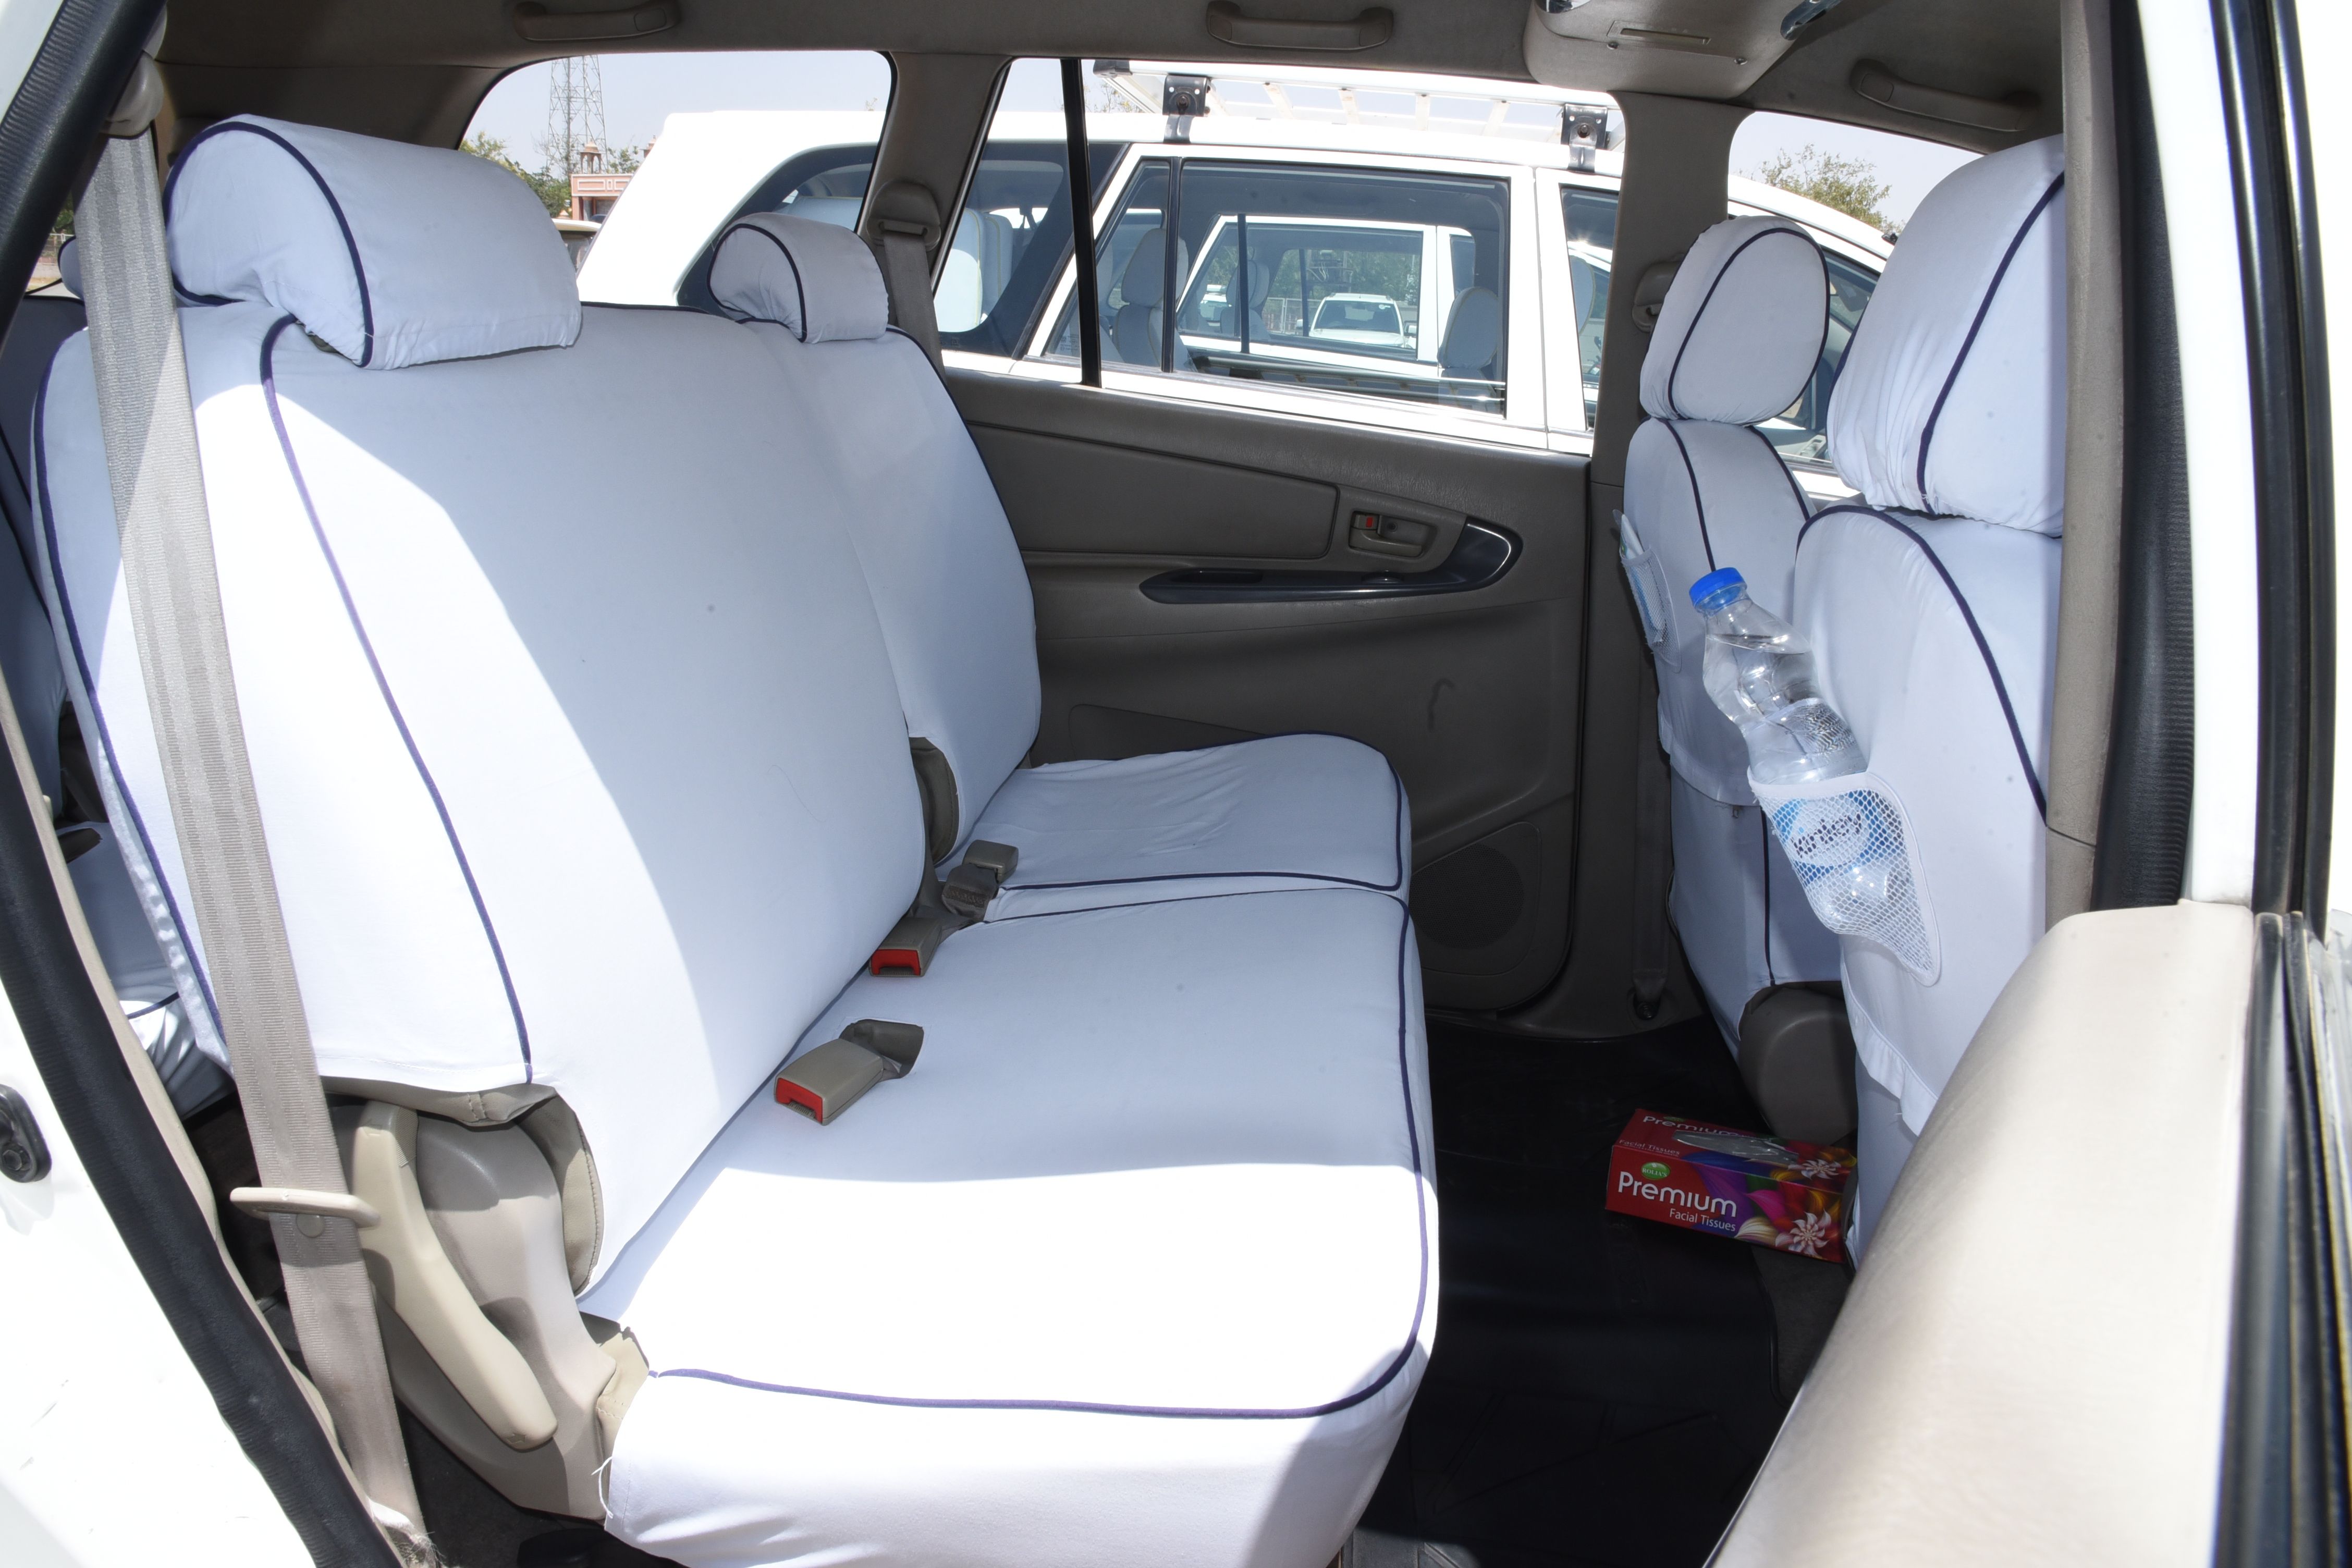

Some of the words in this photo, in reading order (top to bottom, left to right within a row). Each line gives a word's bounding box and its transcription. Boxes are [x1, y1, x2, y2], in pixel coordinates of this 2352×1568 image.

[1648, 1144, 1680, 1155] Tissues
[1618, 1171, 1737, 1217] Premium
[1670, 1208, 1697, 1223] Facial
[1700, 1215, 1736, 1231] Tissues
